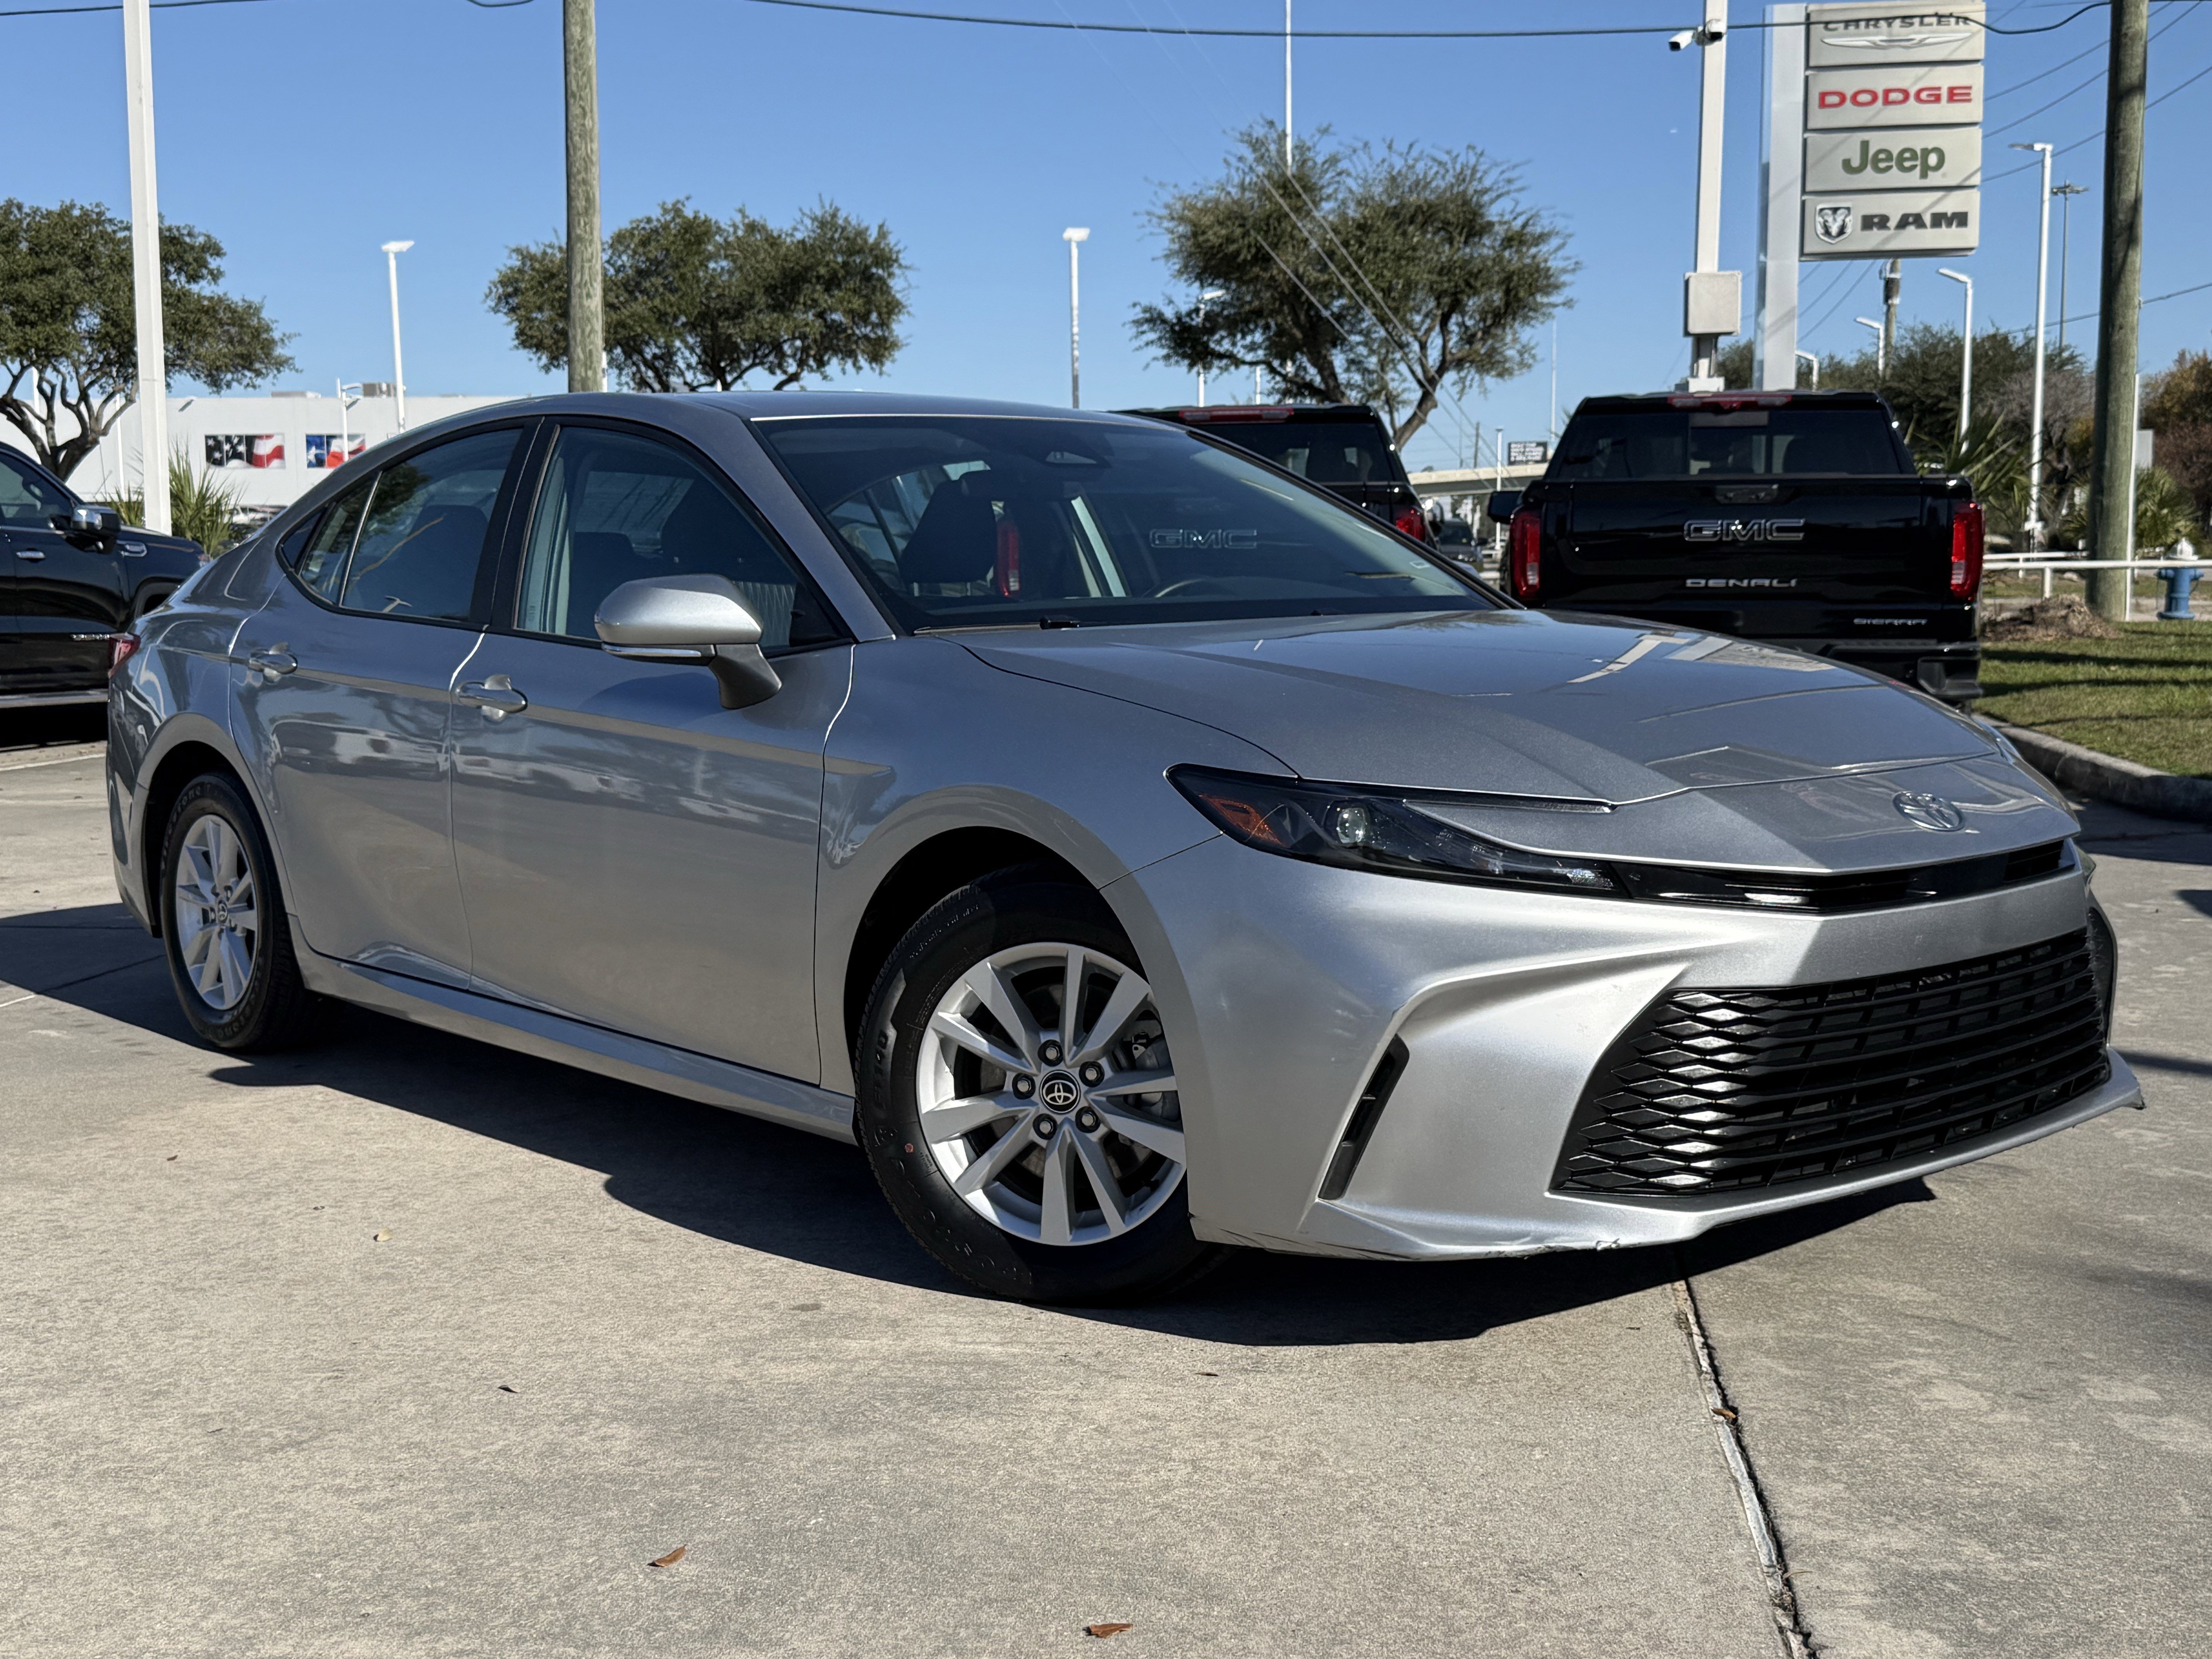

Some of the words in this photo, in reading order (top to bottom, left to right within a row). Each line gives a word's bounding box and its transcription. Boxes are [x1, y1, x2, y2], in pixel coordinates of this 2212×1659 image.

[1823, 14, 1971, 31] CHRYSLER
[1818, 85, 1972, 109] DODGE
[1841, 140, 1946, 180] Jeep
[1860, 211, 1968, 232] RAM
[1149, 529, 1257, 549] GMC
[1684, 518, 1805, 542] GMC
[1685, 578, 1797, 587] DENALI
